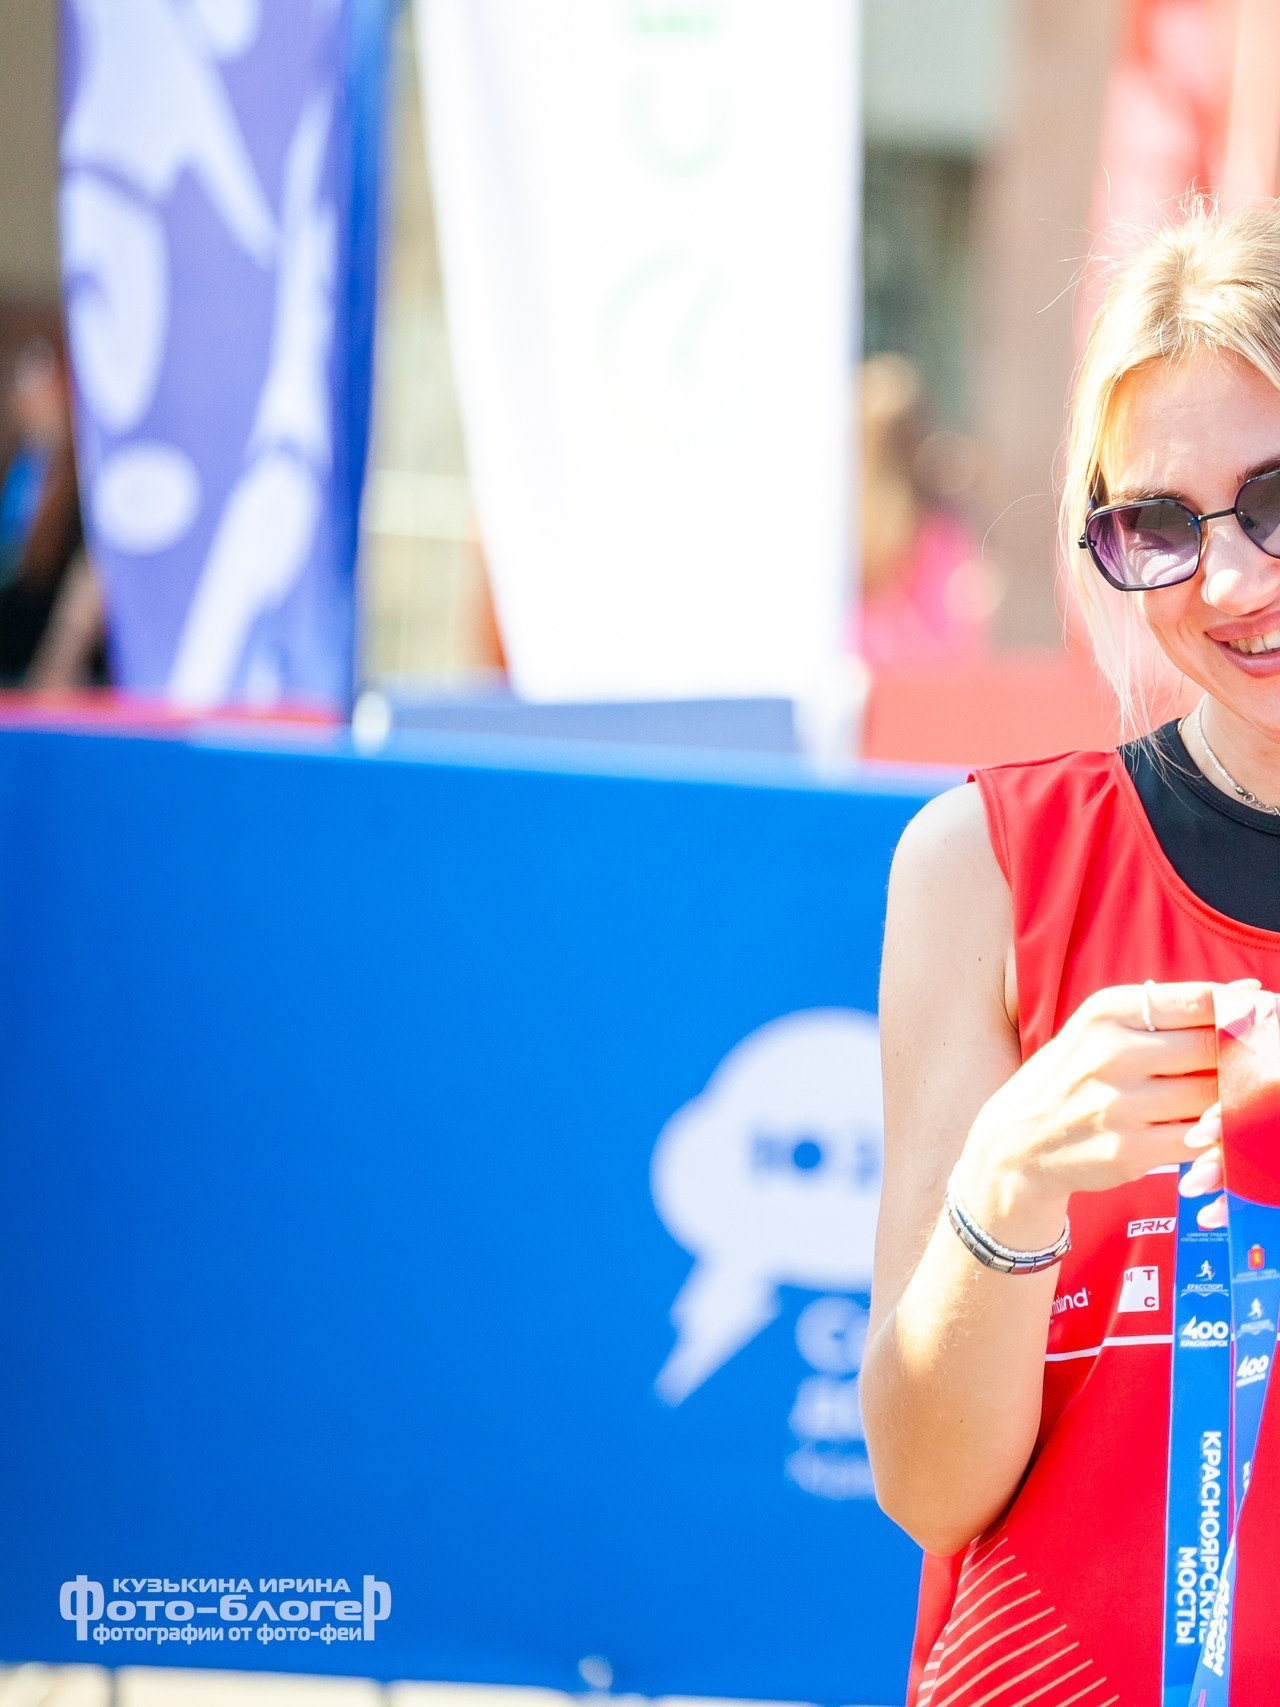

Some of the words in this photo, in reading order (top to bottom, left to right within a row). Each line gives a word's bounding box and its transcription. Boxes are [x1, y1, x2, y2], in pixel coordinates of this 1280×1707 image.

[1130, 1219, 1173, 1235] PRK
[1181, 1315, 1229, 1341] 400
[1236, 1354, 1270, 1378] 400
[1176, 1547, 1197, 1644] МОСТЫ
